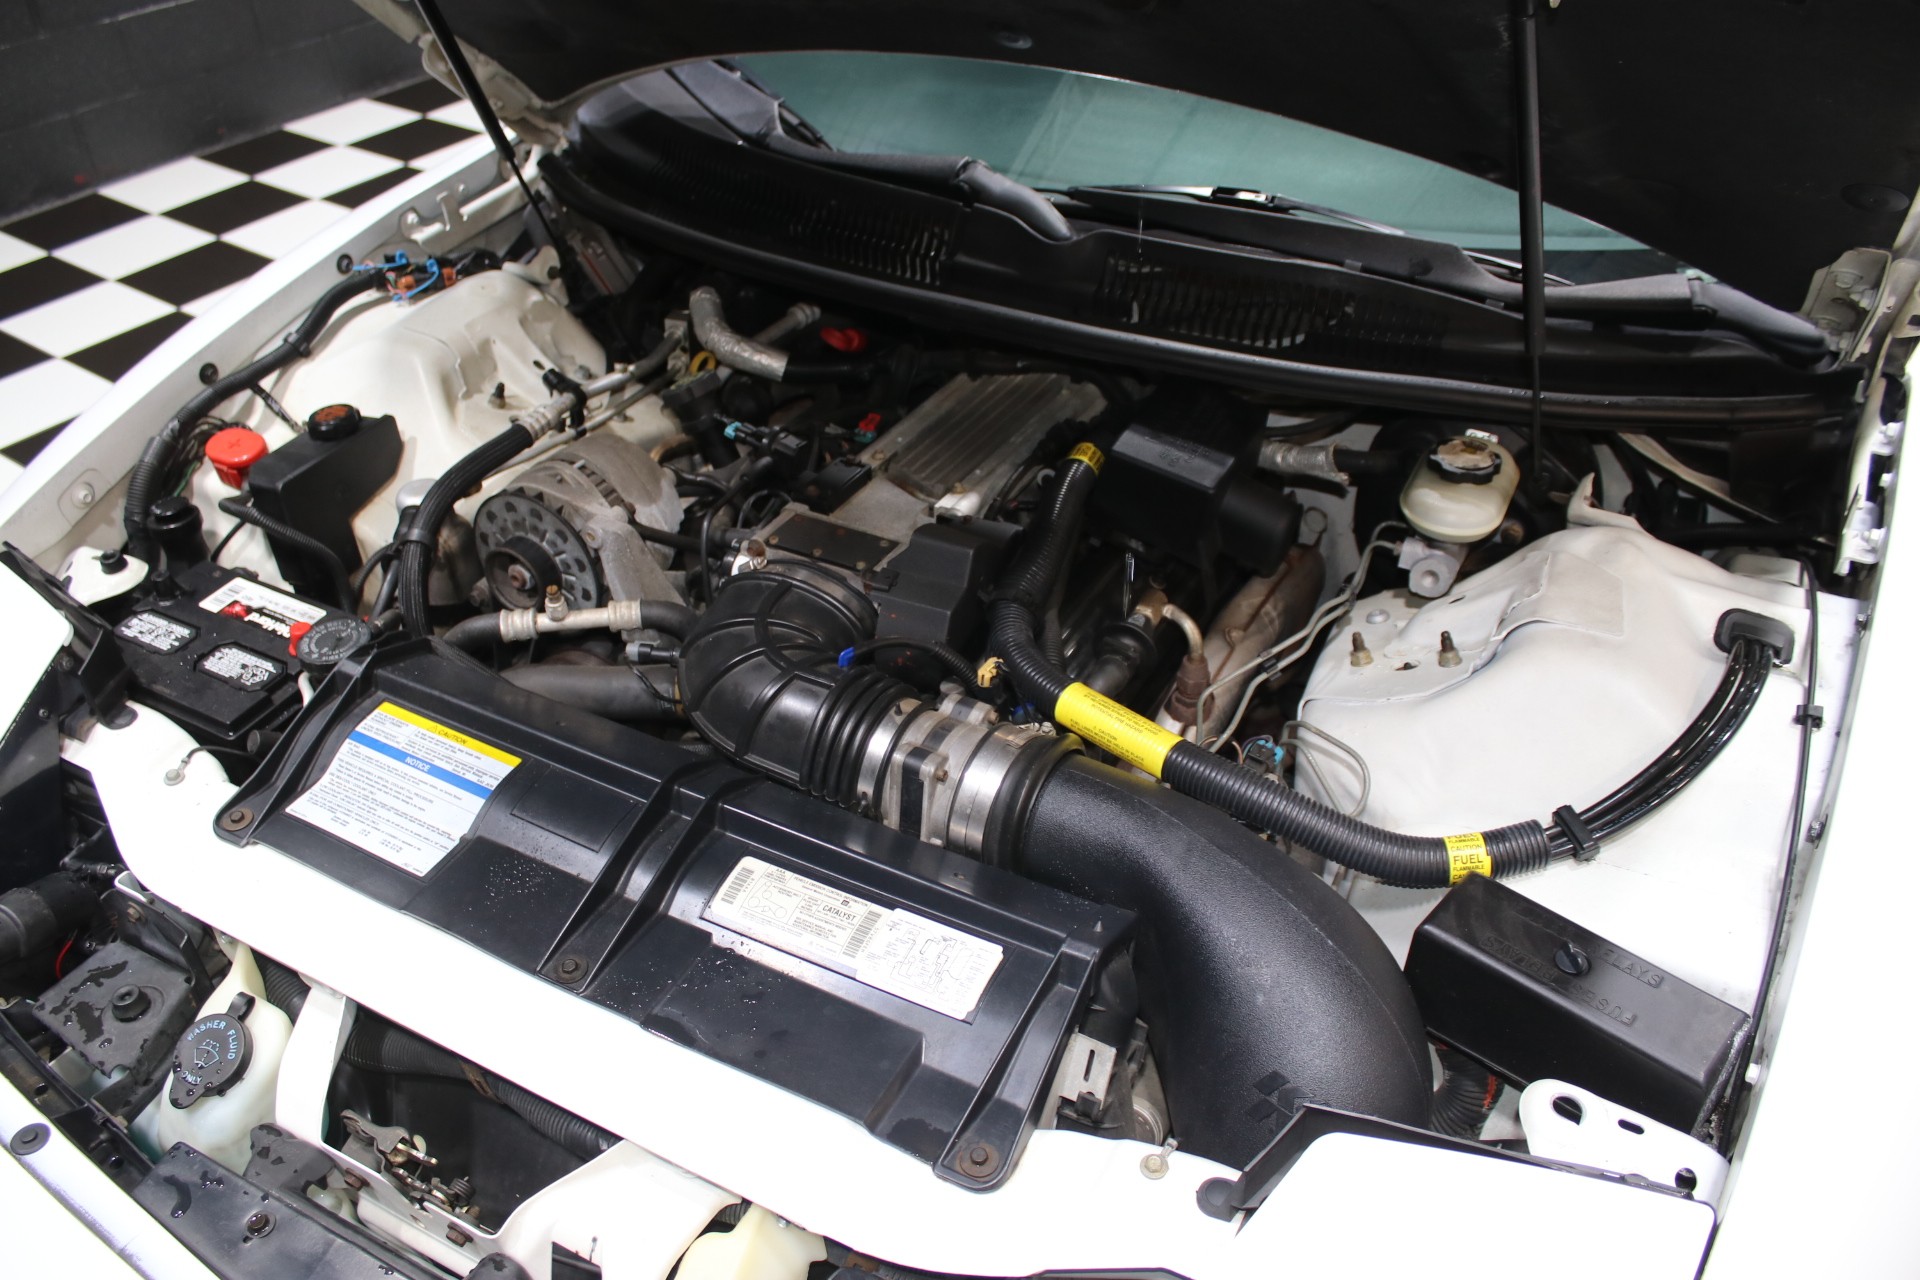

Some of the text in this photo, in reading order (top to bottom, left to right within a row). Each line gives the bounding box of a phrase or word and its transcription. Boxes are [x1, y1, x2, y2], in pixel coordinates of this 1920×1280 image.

[435, 728, 469, 745] CAUTION
[401, 756, 432, 772] NOTICE
[1450, 844, 1483, 852] CAUTION
[1453, 854, 1484, 866] FUEL
[821, 903, 857, 923] CATALYST
[187, 1020, 238, 1060] WASHER FLUID
[182, 1070, 203, 1085] ONLY
